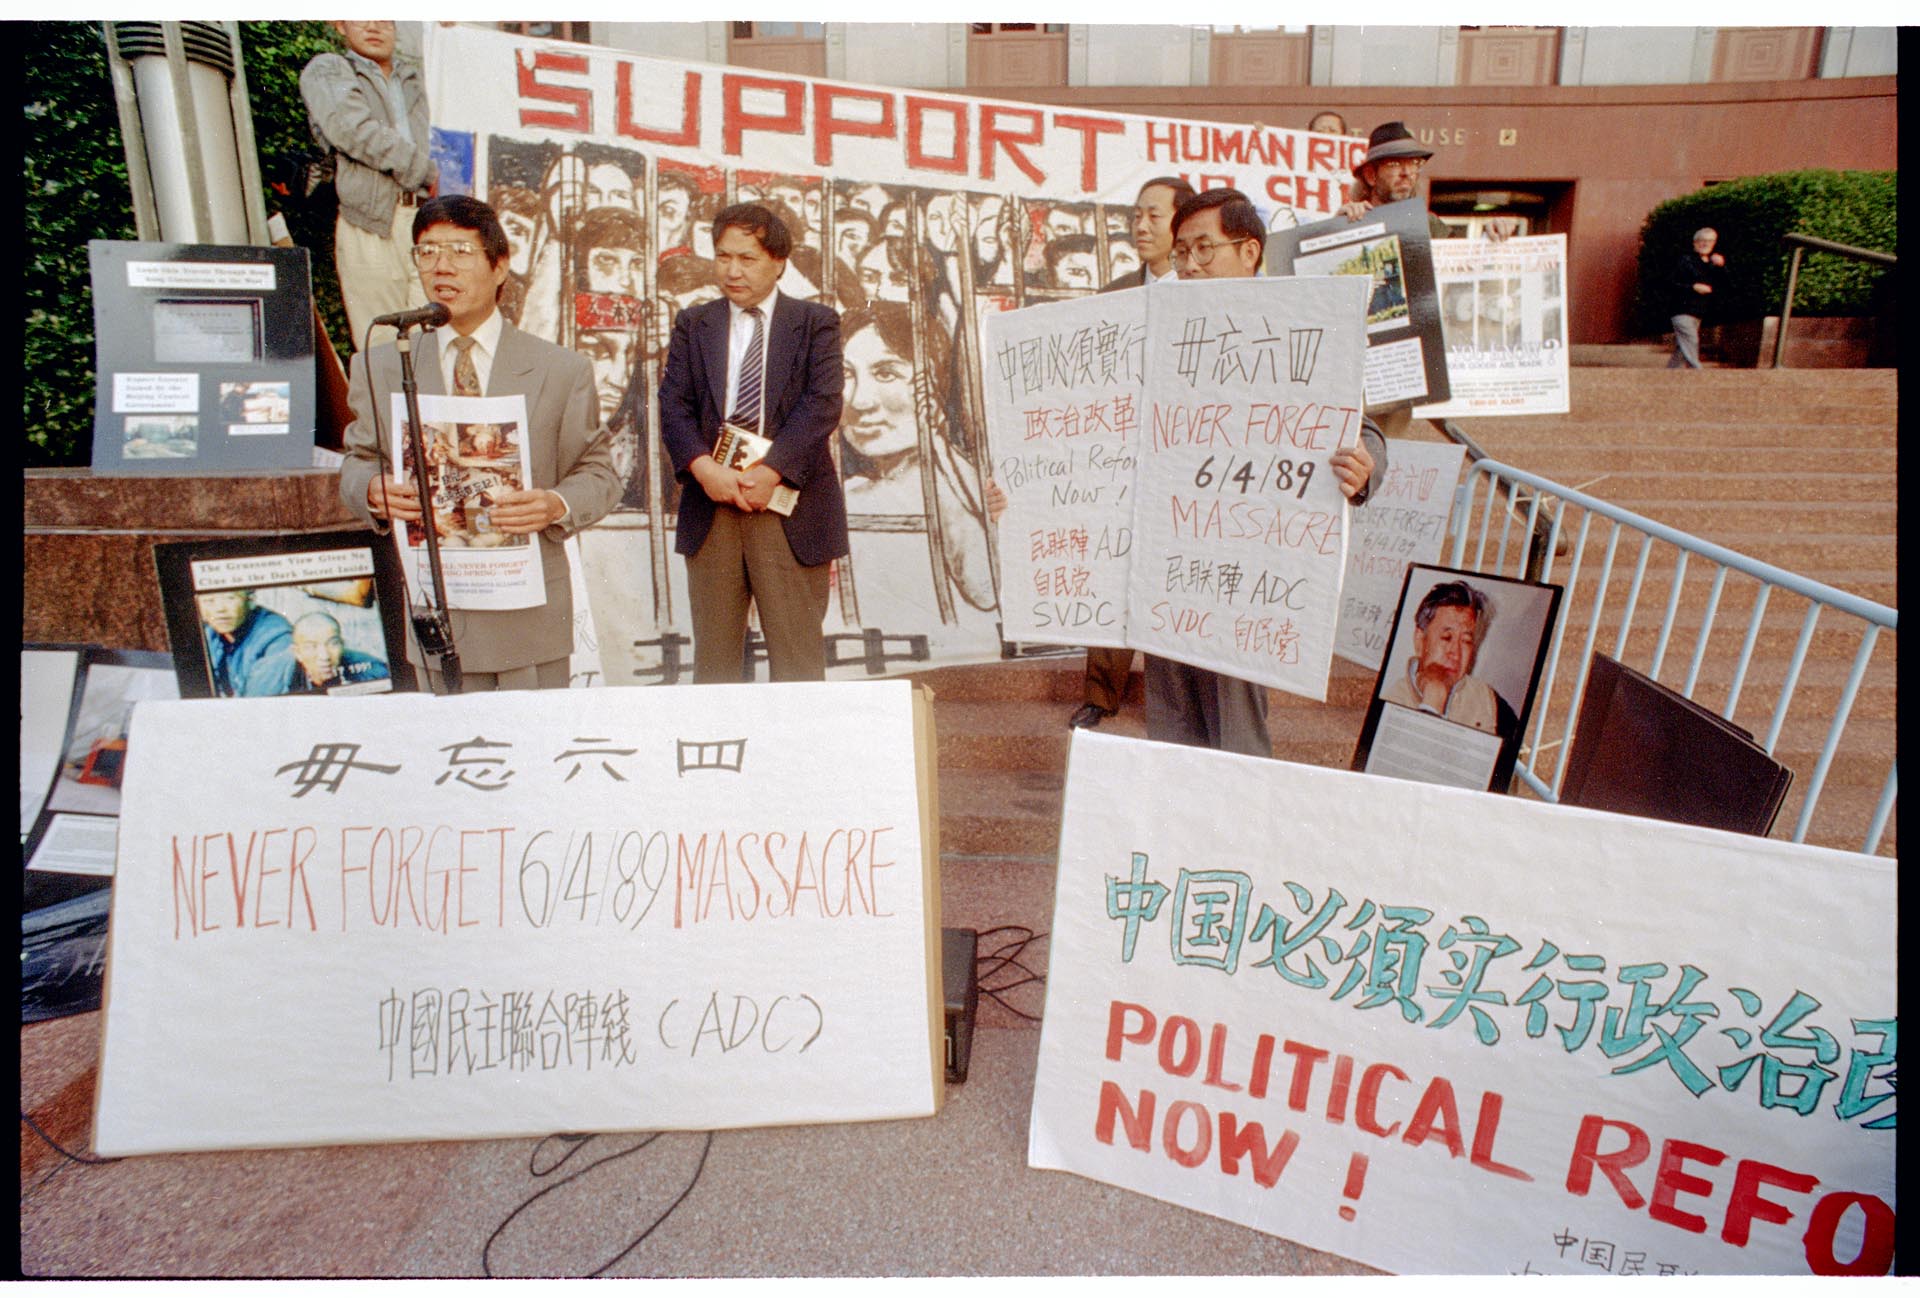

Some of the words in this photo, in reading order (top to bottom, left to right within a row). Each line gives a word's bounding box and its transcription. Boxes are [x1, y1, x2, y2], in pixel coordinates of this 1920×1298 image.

[515, 48, 1126, 193] SUPPORT
[1145, 120, 1295, 171] HUMAN
[1023, 393, 1138, 441] 政治改革
[1153, 402, 1233, 453] NEVER
[1245, 402, 1358, 450] FORGET
[1000, 449, 1074, 494] Political
[1052, 480, 1105, 507] Now
[1195, 454, 1315, 499] 6/4/89
[1172, 495, 1342, 555] MASSACRE
[200, 563, 222, 573] The
[226, 559, 283, 571] Gruesome
[288, 555, 312, 565] View
[249, 572, 266, 582] the
[271, 569, 297, 579] Dark
[302, 566, 334, 577] Secret
[1250, 570, 1308, 611] ADC
[1033, 601, 1116, 628] SVDC
[1151, 601, 1214, 639] SVDC
[275, 735, 748, 798] 毋忘六四
[172, 825, 318, 940] NEVER
[341, 825, 516, 935] FORGET
[518, 829, 670, 929] 6/4/89
[672, 826, 896, 930] MASSACRE
[1095, 1080, 1300, 1190] NOW
[1105, 1000, 1537, 1183] POLITICAL
[1566, 1114, 1897, 1277] REFO
